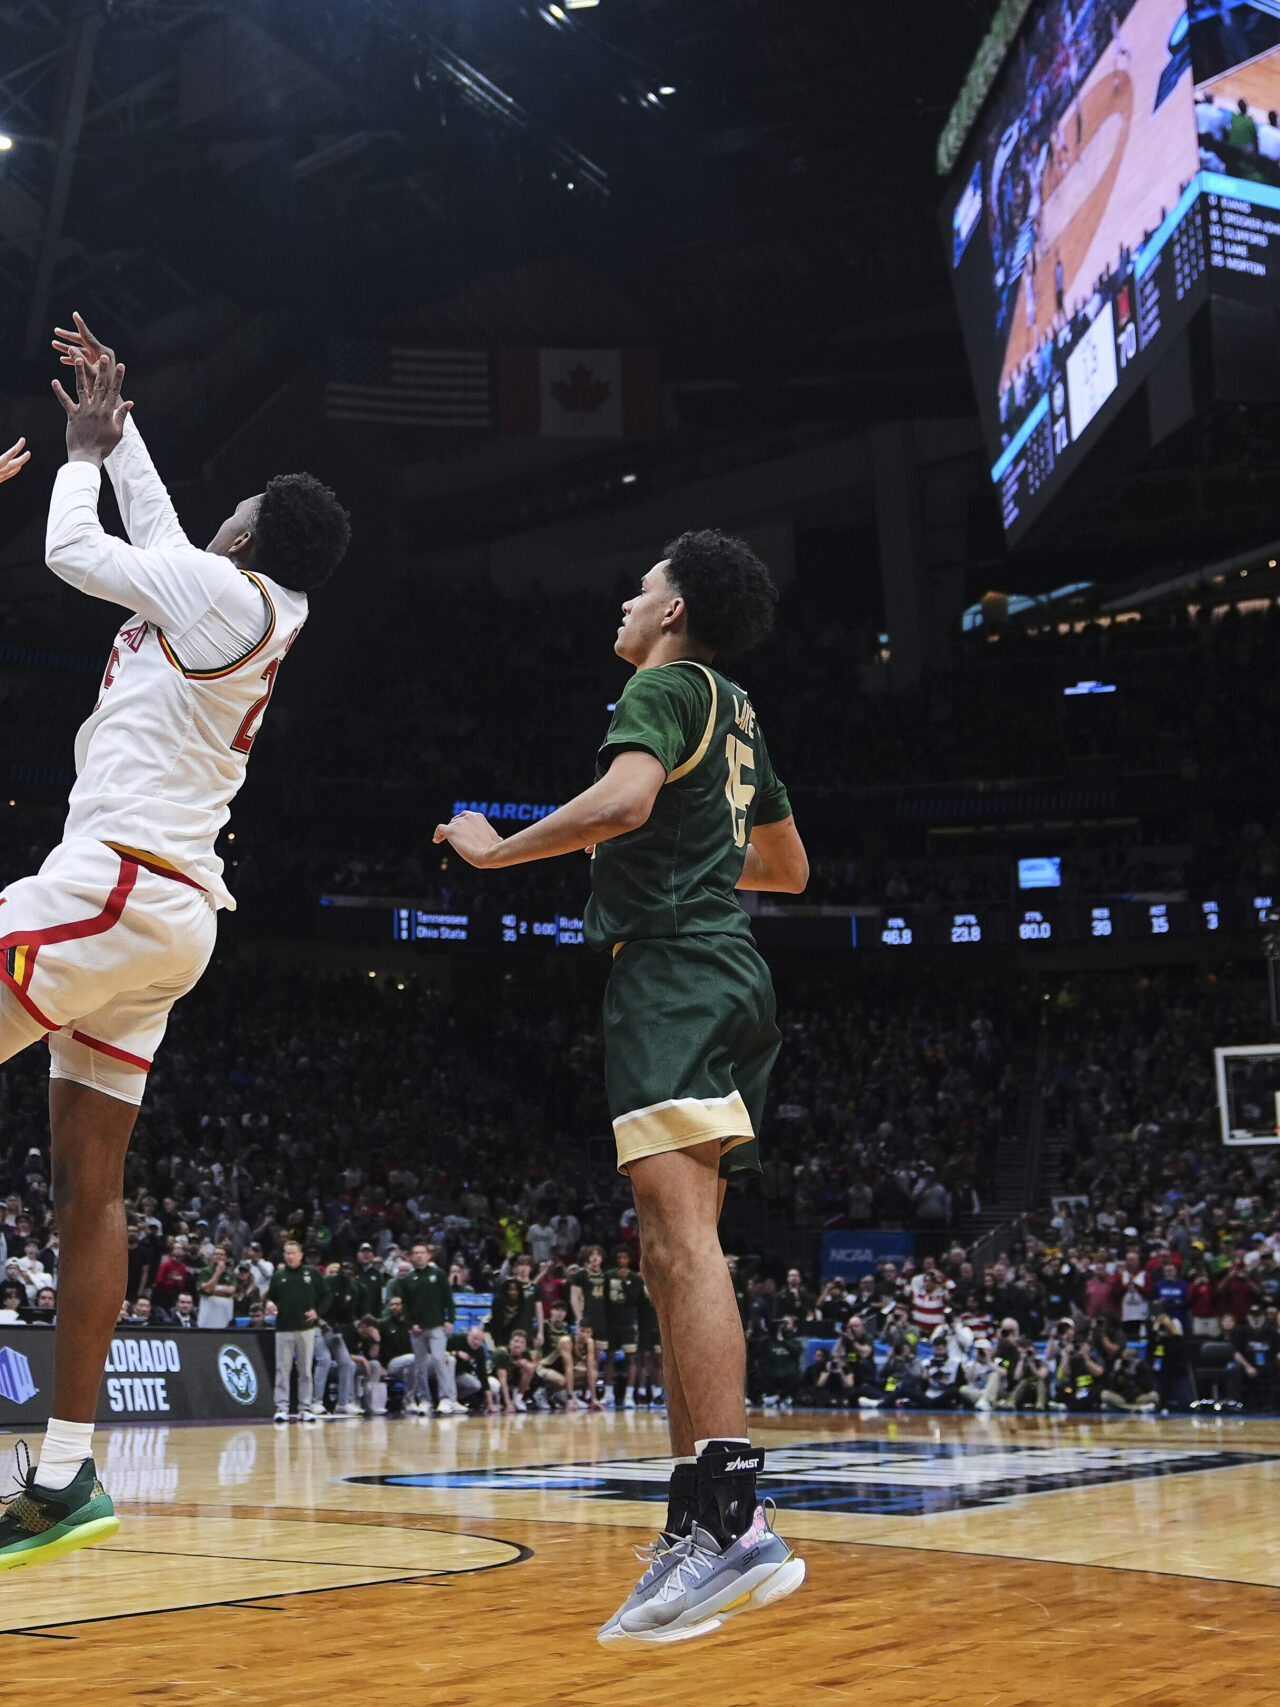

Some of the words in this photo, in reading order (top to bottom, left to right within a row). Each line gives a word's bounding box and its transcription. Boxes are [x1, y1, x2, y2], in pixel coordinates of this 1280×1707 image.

[416, 911, 468, 926] Tennessee
[1151, 917, 1169, 934] 15
[1207, 913, 1219, 930] 3
[440, 928, 468, 940] State
[520, 921, 527, 935] 2
[951, 925, 981, 942] 23.8
[1019, 922, 1051, 940] 80.0
[107, 1377, 170, 1412] STATE
[724, 1455, 760, 1472] ZAMST
